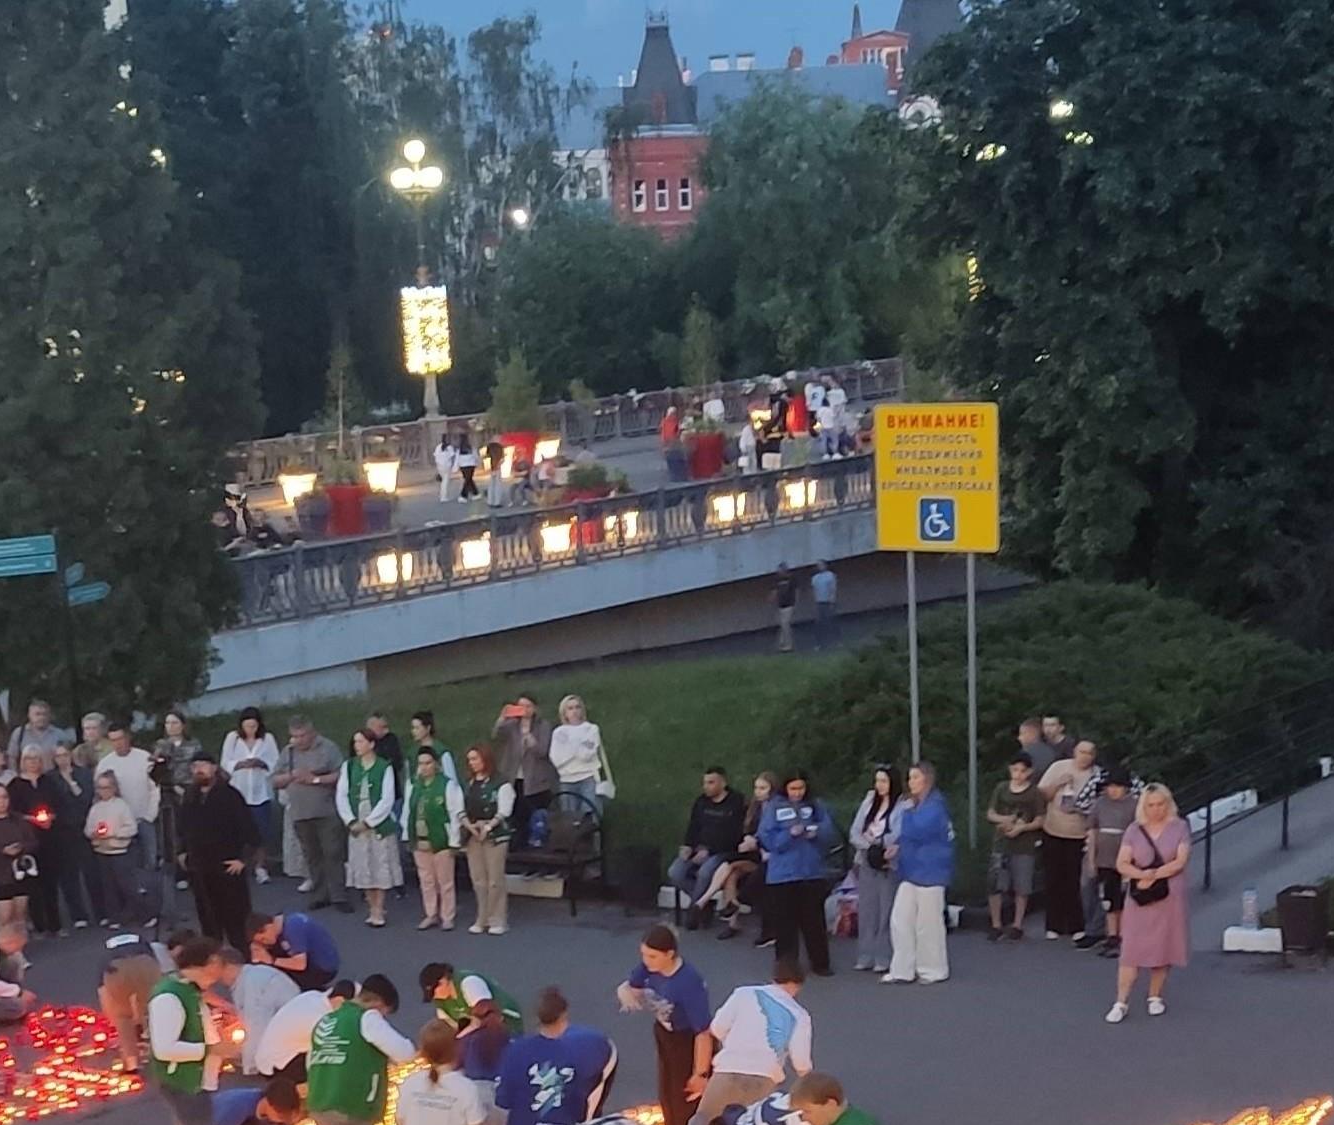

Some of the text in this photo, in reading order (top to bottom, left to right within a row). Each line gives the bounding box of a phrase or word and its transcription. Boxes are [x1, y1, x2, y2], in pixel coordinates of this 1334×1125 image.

[887, 414, 985, 429] ВНИМАНИЕ!
[895, 434, 977, 446] ДОСТУПНОСТЬ
[890, 450, 983, 460] ПЕРЕДВИЖЕНИЯ
[896, 466, 963, 476] ИНВАЛИДОВ
